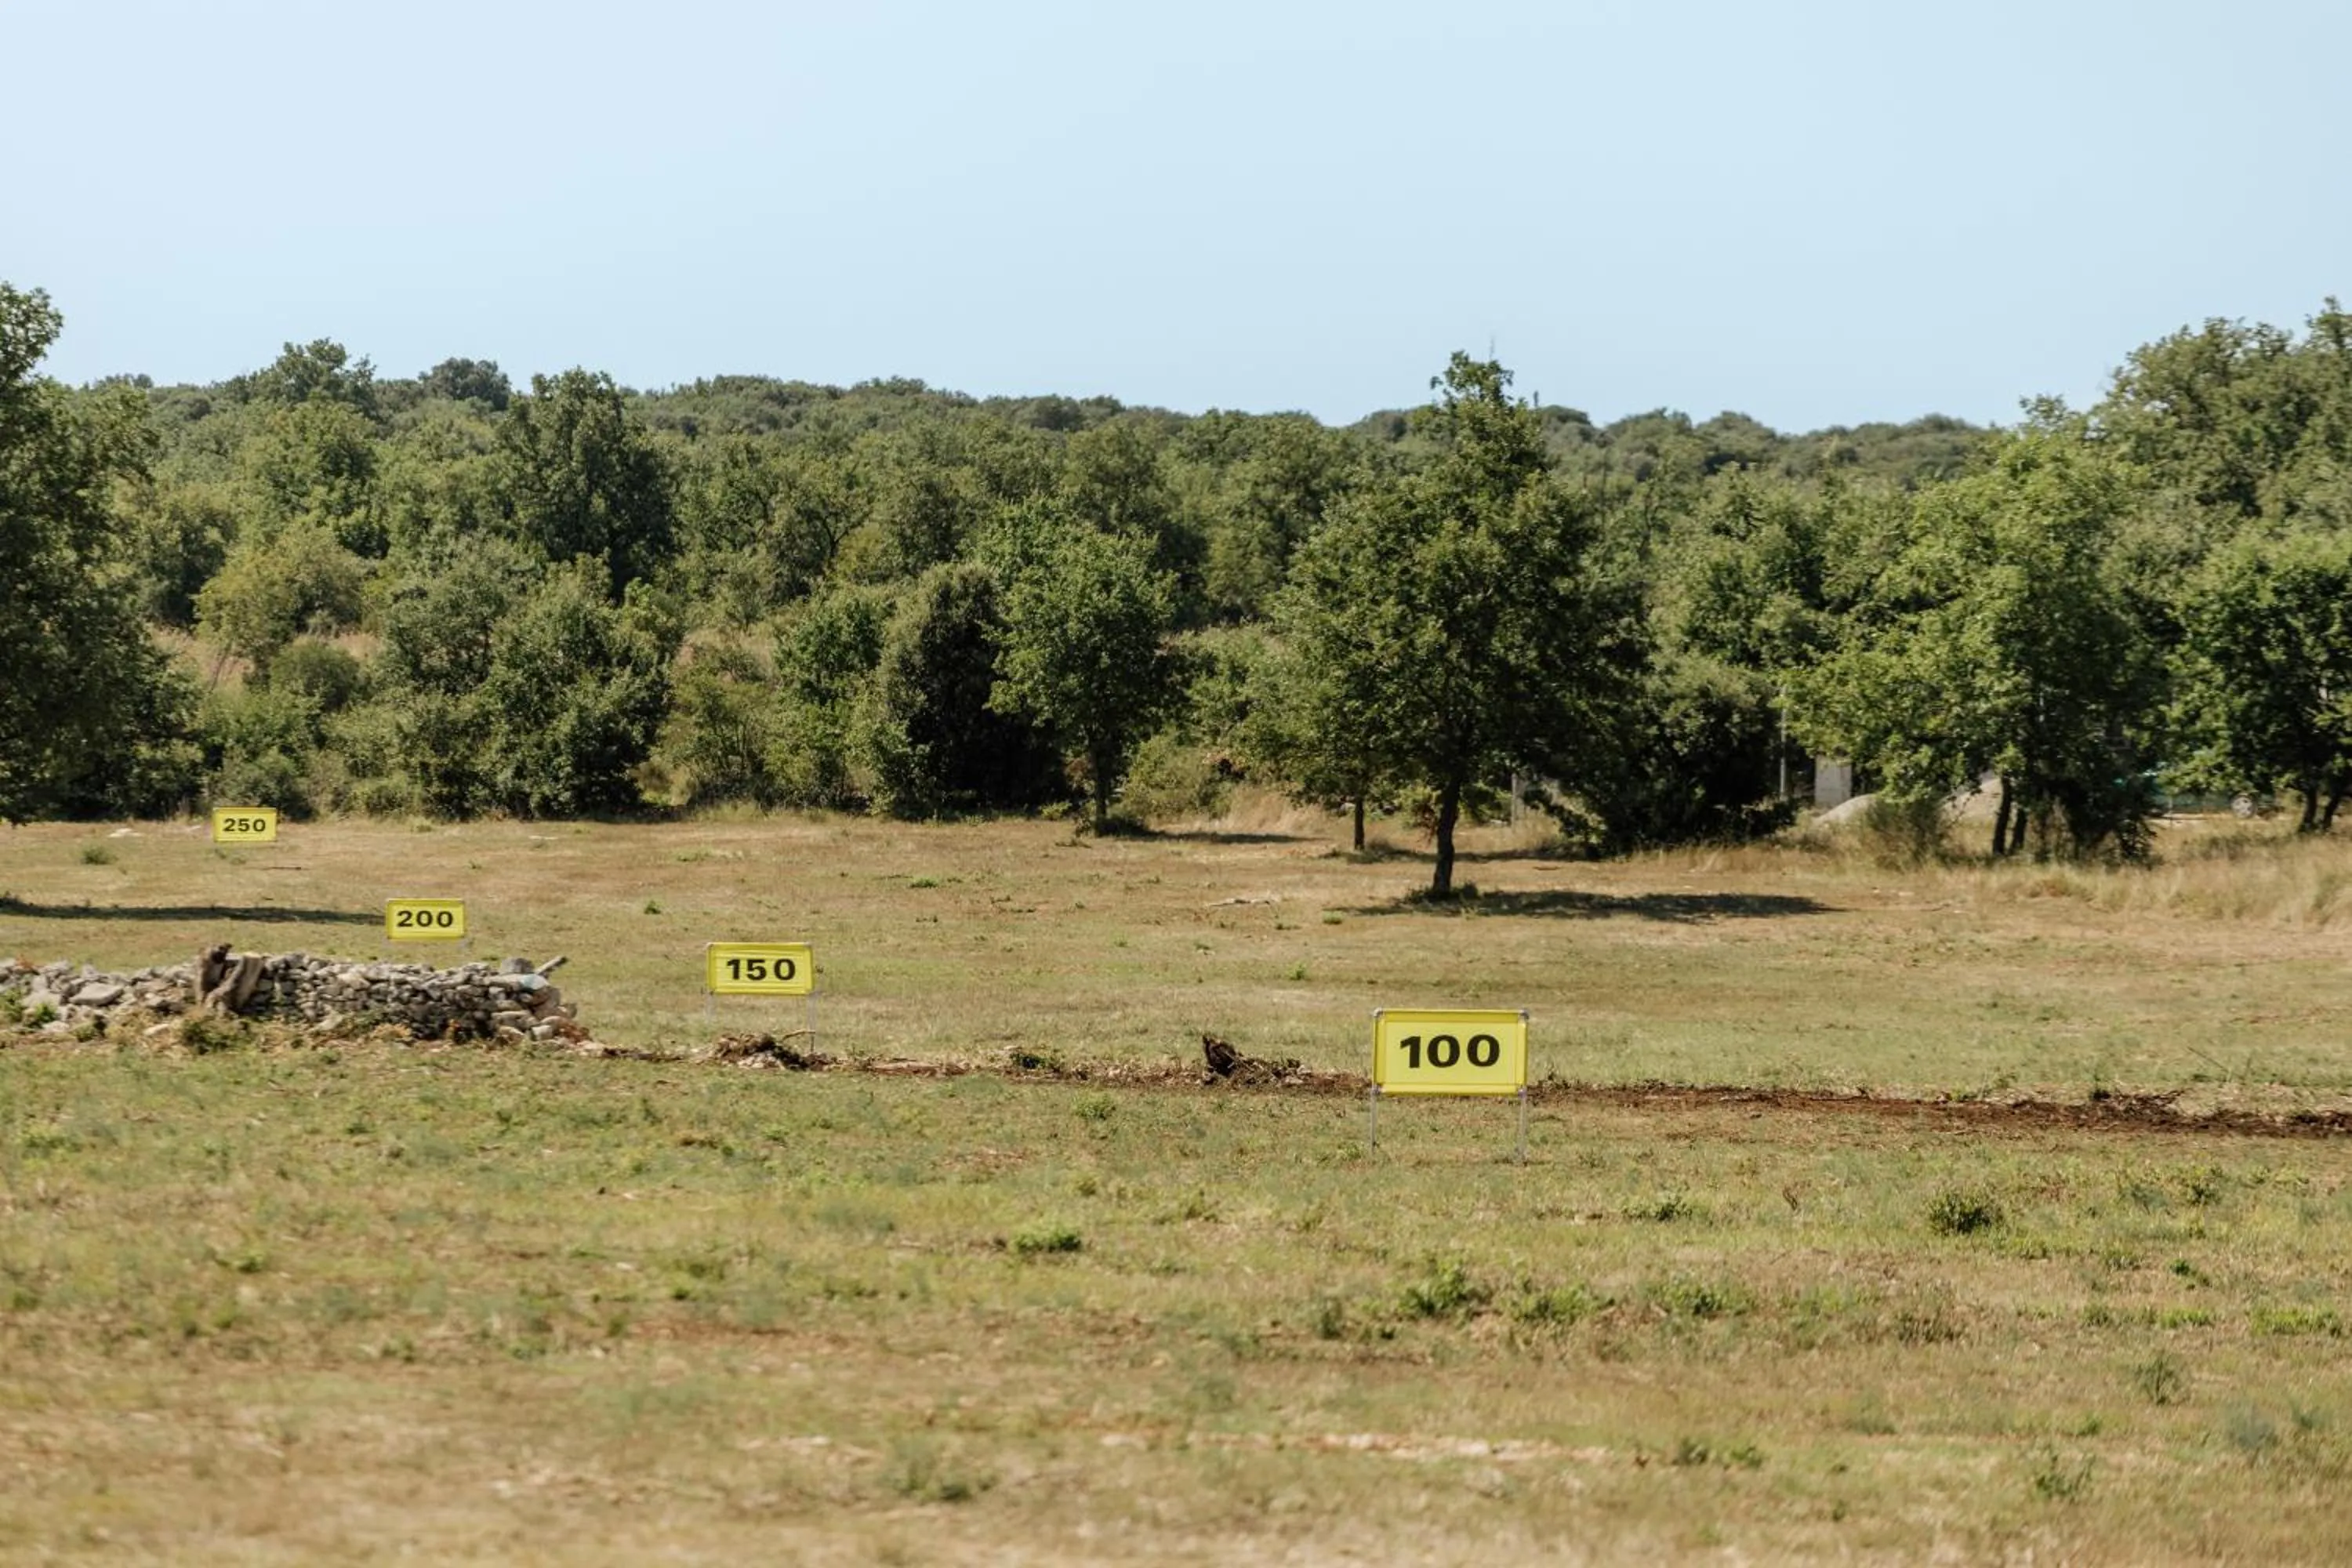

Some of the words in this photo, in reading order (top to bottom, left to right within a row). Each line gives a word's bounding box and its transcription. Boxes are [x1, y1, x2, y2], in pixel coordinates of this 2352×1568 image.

[223, 818, 266, 833] 250
[397, 910, 454, 928] 200
[727, 958, 796, 981] 150
[1399, 1034, 1501, 1069] 100
